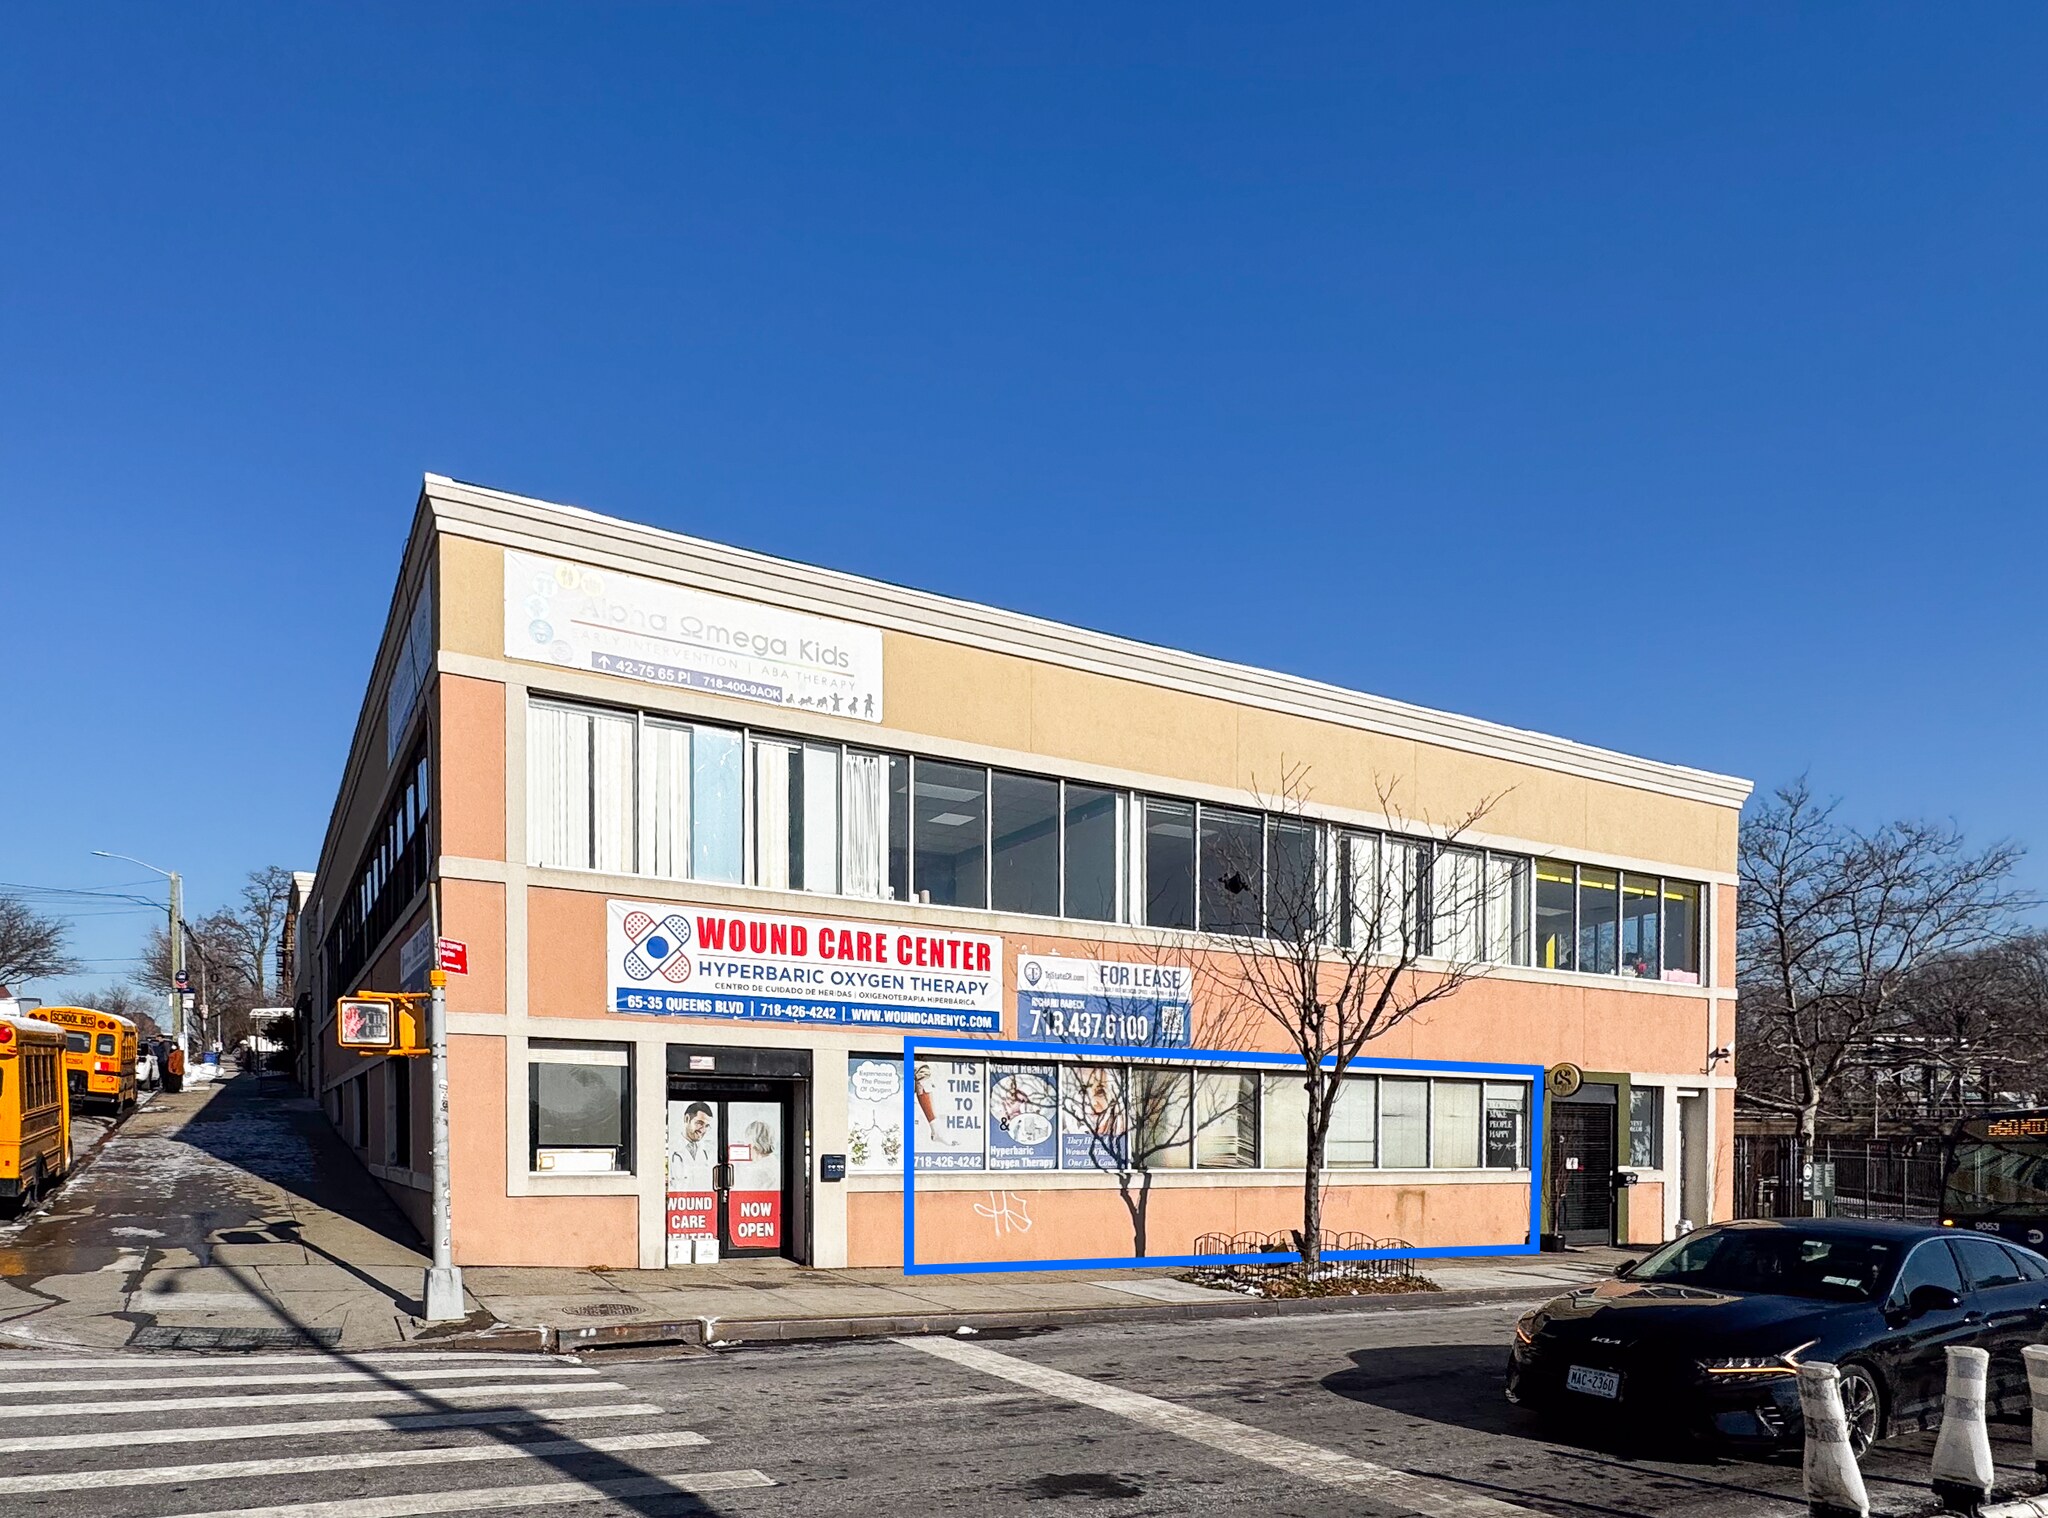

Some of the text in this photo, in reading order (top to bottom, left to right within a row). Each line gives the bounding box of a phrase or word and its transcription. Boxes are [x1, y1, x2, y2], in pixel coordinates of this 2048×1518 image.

[800, 638, 850, 668] Kids
[627, 640, 738, 669] INTERVENTION
[762, 666, 789, 679] ABA
[797, 672, 856, 690] THERAPY
[616, 660, 655, 678] 42-75
[657, 668, 675, 681] 65
[703, 676, 782, 700] 718-400-9AOK
[697, 916, 991, 971] WOUND CARE CENTER
[699, 961, 989, 996] HYPERBARIC OXYGEN THERAPY
[1100, 965, 1182, 989] FOR LEASE
[715, 982, 750, 991] CENTRO
[766, 986, 803, 995] CUIDADO
[818, 989, 852, 998] HERIDAS
[859, 992, 925, 1003] OXIGENOTERAPIA
[627, 994, 992, 1028] 65-35 QUEENS BLVD 718-426-4242 WWW.WOUNDCARENYC.COM
[53, 1013, 94, 1025] SCHOOL BUS
[951, 1062, 976, 1075] IT'S
[947, 1080, 980, 1092] TIME
[955, 1098, 973, 1110] TO
[946, 1115, 981, 1129] HEAL
[1000, 1117, 1010, 1131] &
[990, 1146, 1034, 1157] Hyperbaric
[914, 1156, 982, 1168] 718-426-4242
[990, 1158, 1054, 1169] Oxygen Therapy
[668, 1197, 713, 1211] WOUND
[740, 1202, 773, 1217] NOW
[671, 1214, 706, 1229] CARE
[738, 1222, 774, 1237] OPEN
